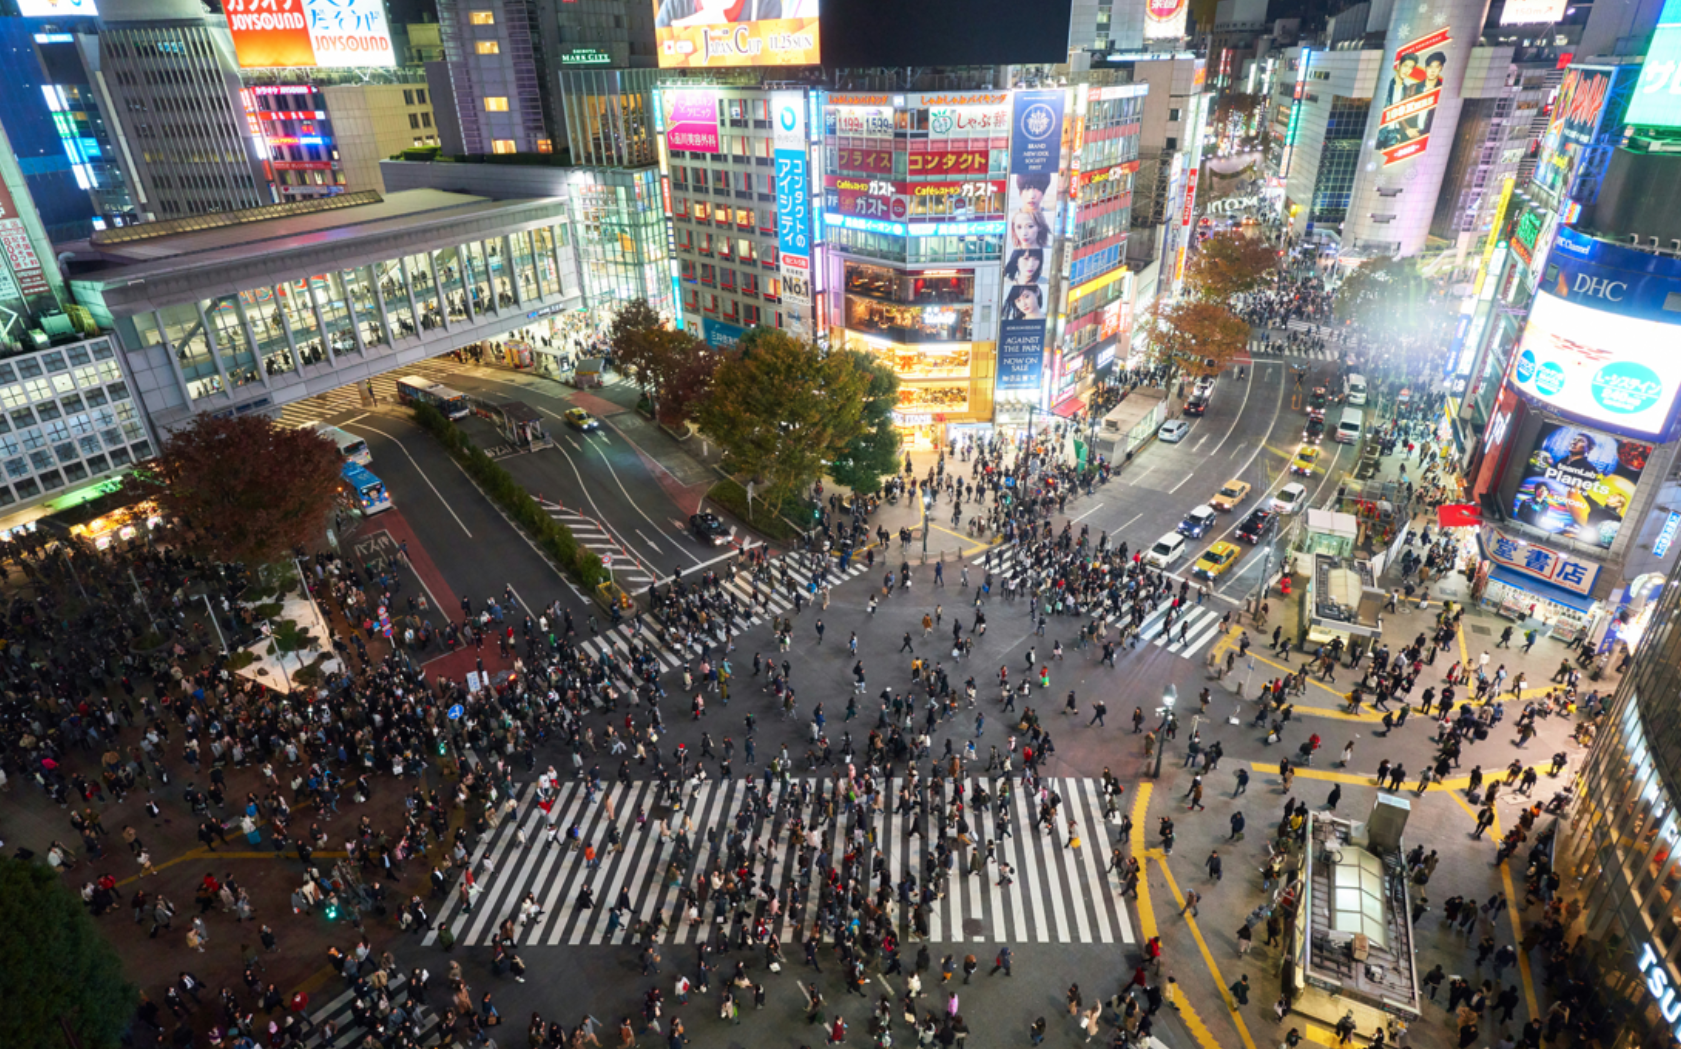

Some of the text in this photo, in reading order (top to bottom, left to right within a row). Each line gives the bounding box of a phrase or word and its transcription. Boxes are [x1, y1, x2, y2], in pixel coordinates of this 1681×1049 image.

[231, 12, 304, 30] JOYSOUND
[315, 35, 389, 51] JOYSOUND
[702, 28, 733, 64] JAPAN
[734, 26, 762, 54] CUP
[562, 54, 586, 62] MARK
[909, 153, 986, 170] コンタクト
[869, 180, 896, 196] ガスト
[961, 182, 998, 197] ガスト
[778, 159, 795, 247] アイシティ
[793, 160, 806, 248] コンタクトの
[855, 196, 888, 216] ガスト
[1573, 273, 1627, 302] DHC
[1003, 344, 1041, 353] THE PAIN
[1005, 336, 1040, 344] AGAINST
[1003, 357, 1024, 365] NOW
[1557, 462, 1596, 479] teamLab
[1544, 467, 1611, 495] Planets
[1638, 941, 1681, 1046] TSU
